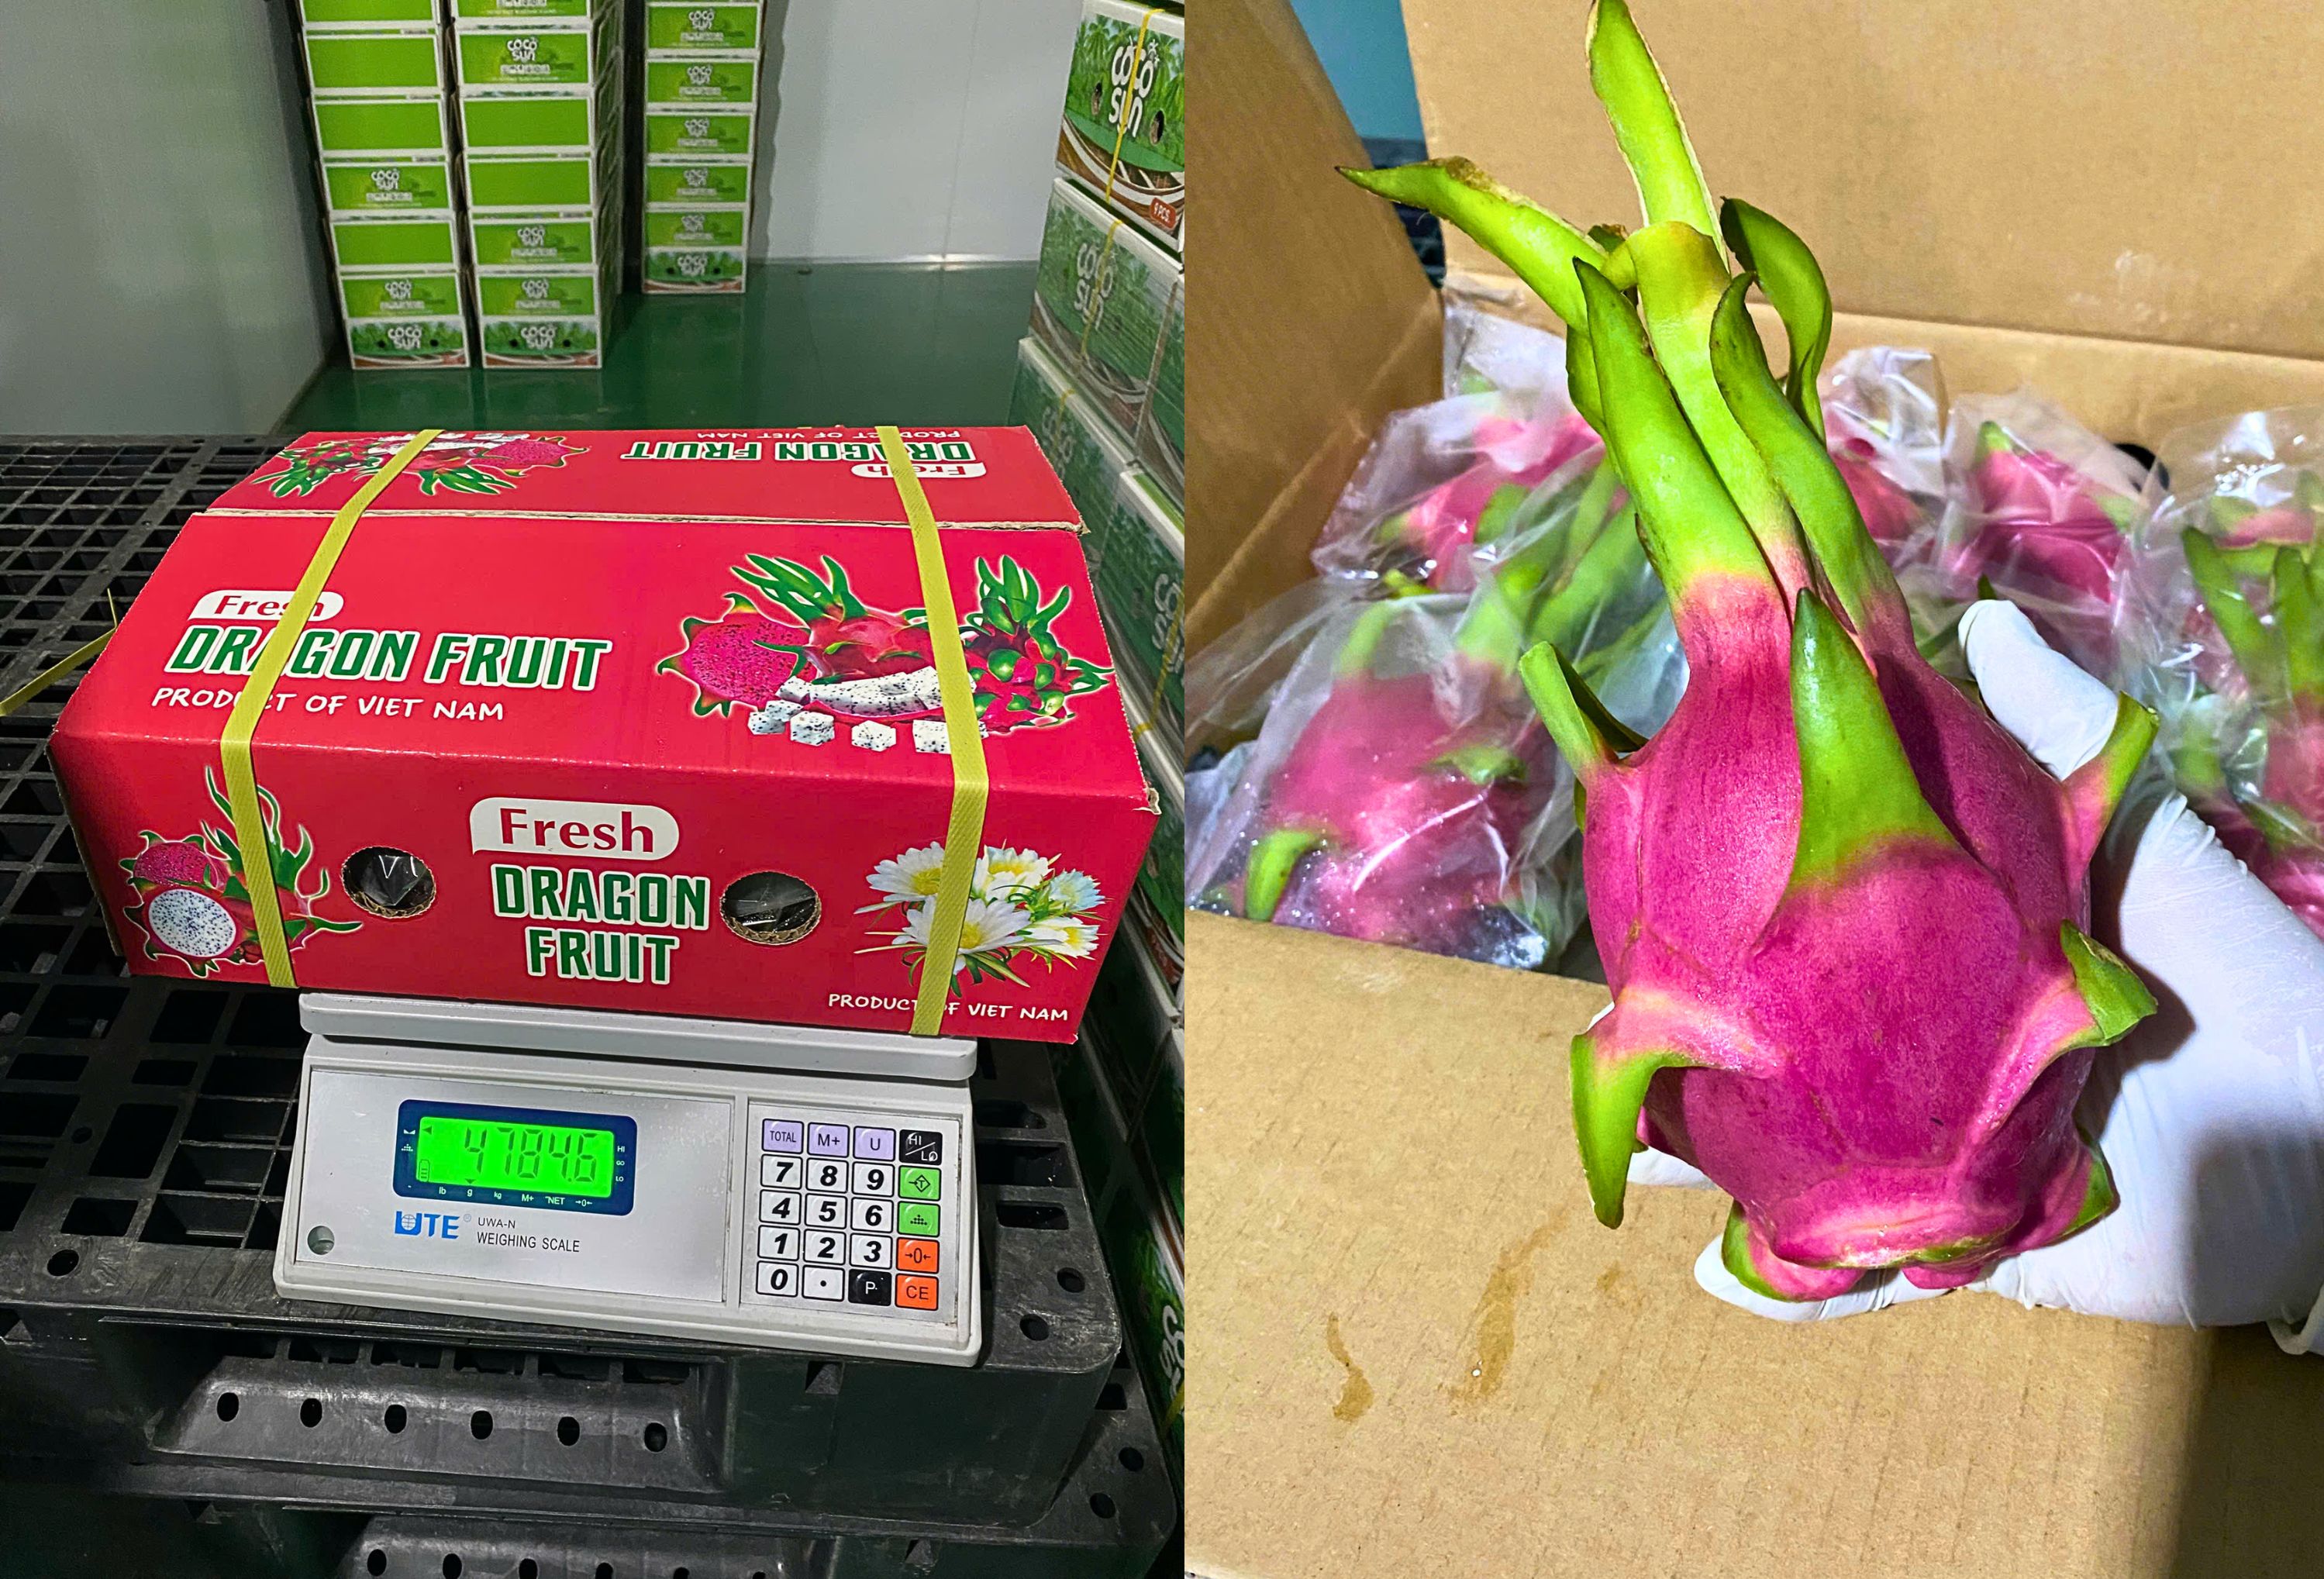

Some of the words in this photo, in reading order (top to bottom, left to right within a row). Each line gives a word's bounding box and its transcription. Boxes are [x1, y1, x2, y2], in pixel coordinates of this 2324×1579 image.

[620, 441, 762, 461] FRUIT
[867, 465, 967, 476] Freh
[164, 625, 419, 682] DRGON
[424, 633, 612, 691] FRUIT
[151, 687, 298, 712] PRODT
[305, 695, 347, 715] OF
[358, 695, 423, 719] VIET
[433, 699, 504, 721] NAM
[499, 807, 654, 853] Fresh
[491, 864, 710, 931] DRAGON
[525, 926, 680, 985] FRUIT
[944, 1002, 960, 1015] F
[967, 1003, 1013, 1019] VIET
[1019, 1007, 1069, 1022] NAM
[770, 1130, 797, 1143] TOTAL
[817, 1133, 840, 1147] M+
[870, 1137, 881, 1151] U
[776, 1161, 794, 1183] 7
[819, 1165, 838, 1187] 8
[867, 1169, 884, 1190] 9
[771, 1197, 791, 1219] 4
[818, 1201, 837, 1222] 5
[865, 1205, 883, 1226] 6
[395, 1211, 460, 1239] UTE
[478, 1217, 516, 1229] UWA-N
[477, 1231, 536, 1248] WEIGHING
[542, 1237, 580, 1253] SCALE
[774, 1233, 788, 1254] 1
[817, 1236, 836, 1258] 2
[864, 1240, 882, 1262] 3
[770, 1268, 788, 1291] 0
[905, 1285, 929, 1301] CE
